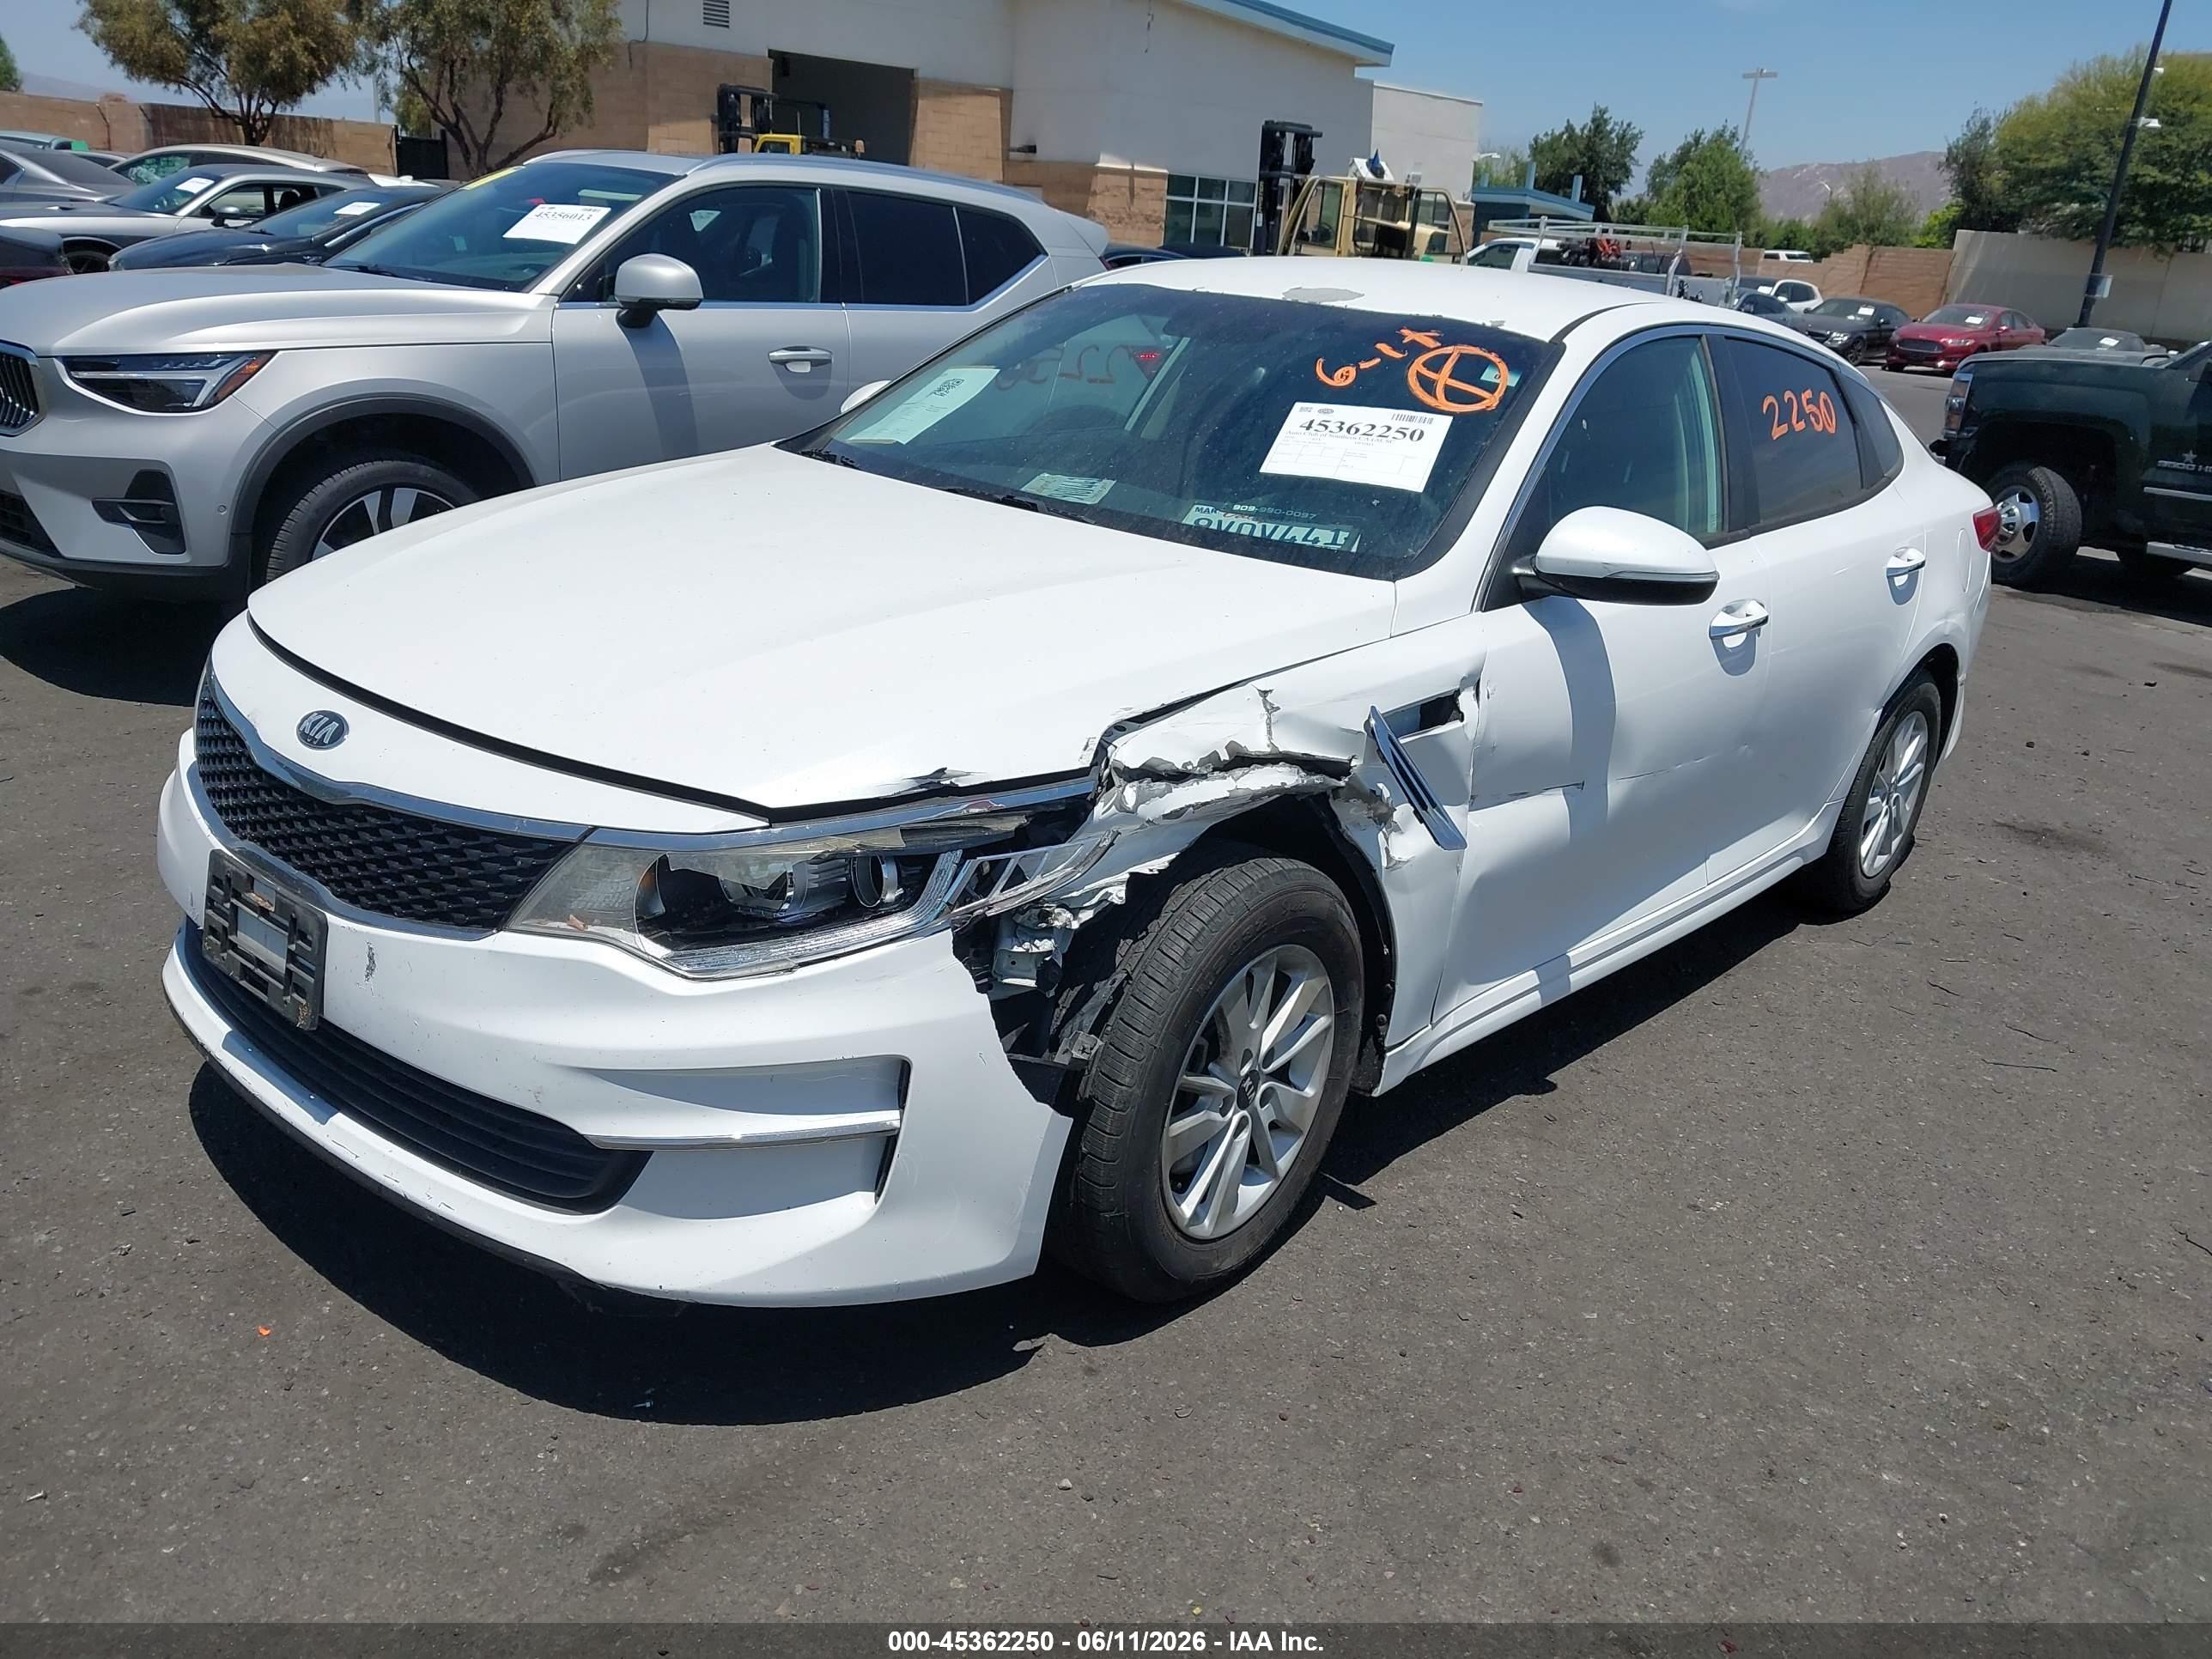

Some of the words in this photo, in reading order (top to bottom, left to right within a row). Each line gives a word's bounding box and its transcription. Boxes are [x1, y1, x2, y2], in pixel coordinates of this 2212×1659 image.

[1763, 389, 1836, 440] 2250
[1299, 418, 1425, 442] 45362250
[299, 712, 339, 744] KIA
[1242, 1076, 1256, 1105] KIA
